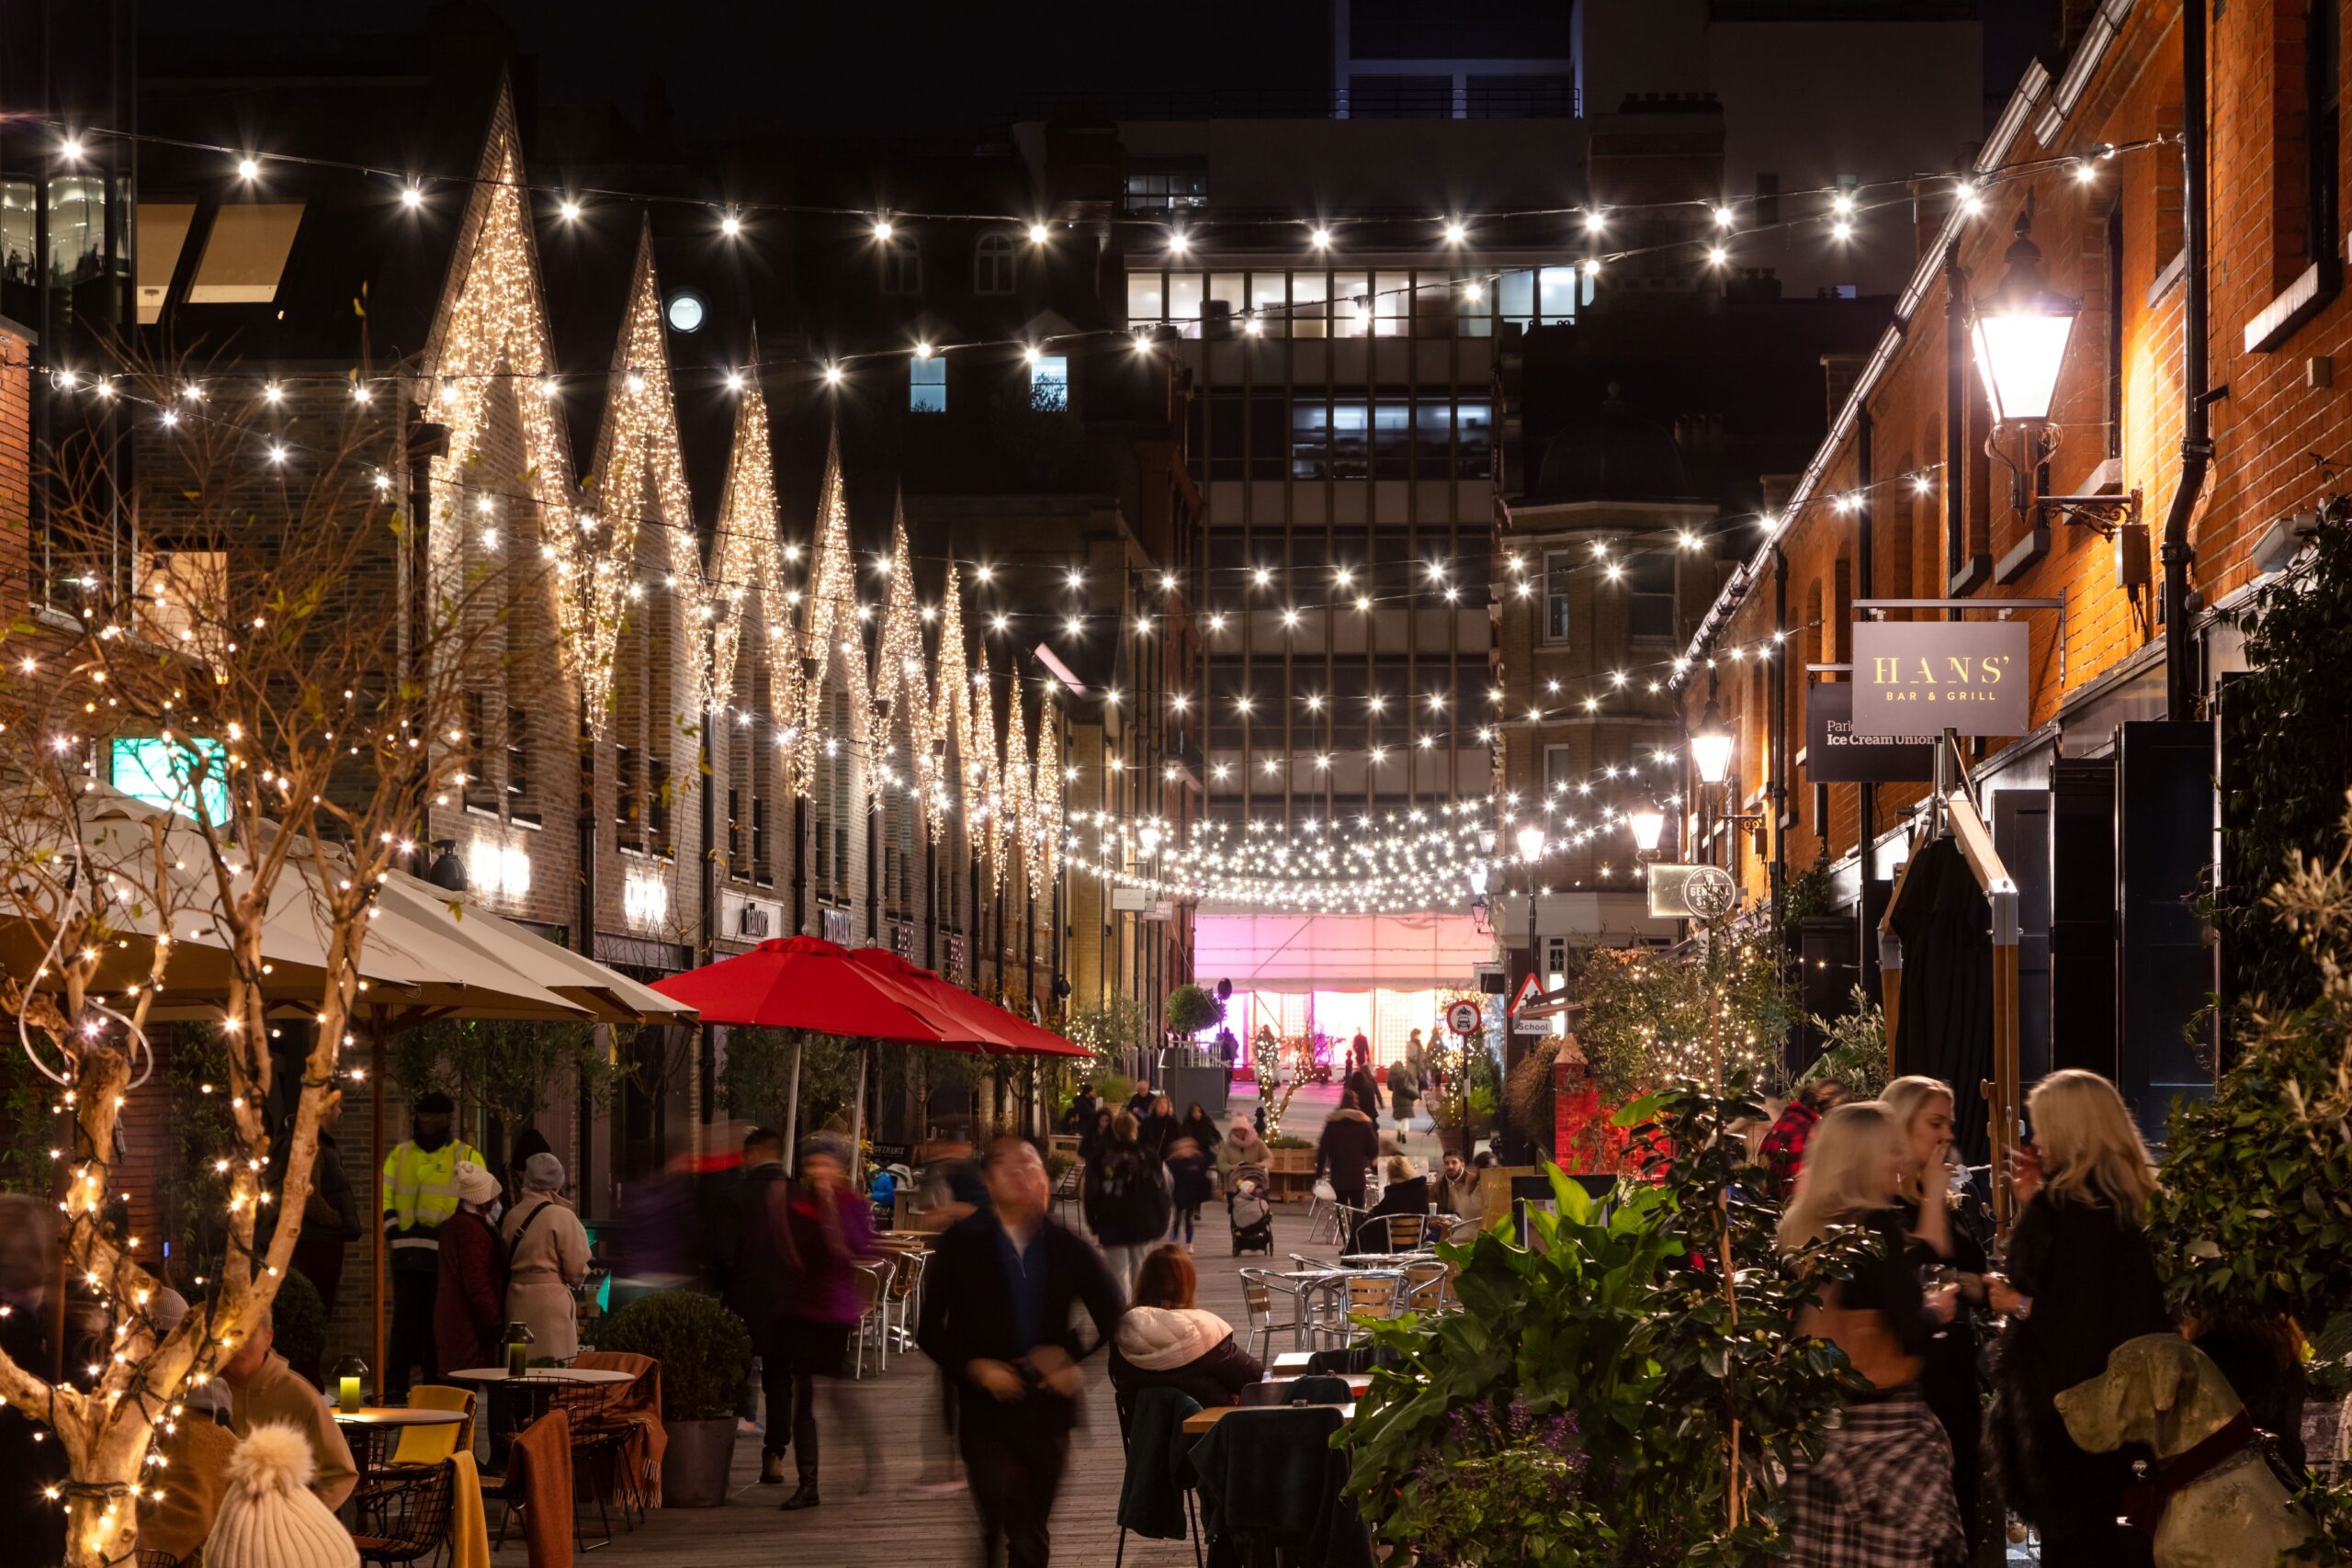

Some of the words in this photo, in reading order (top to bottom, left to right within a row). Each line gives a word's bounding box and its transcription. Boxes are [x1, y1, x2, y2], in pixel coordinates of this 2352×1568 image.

[1886, 692, 1917, 701] BAR
[1928, 692, 1936, 701] &
[1947, 692, 1996, 701] GRILL
[1826, 720, 1853, 732] Parl
[1826, 734, 1848, 746] Ice
[1849, 735, 1894, 745] Cream
[1895, 735, 1936, 745] Union
[1690, 886, 1730, 897] GENRL
[1518, 1022, 1548, 1031] School
